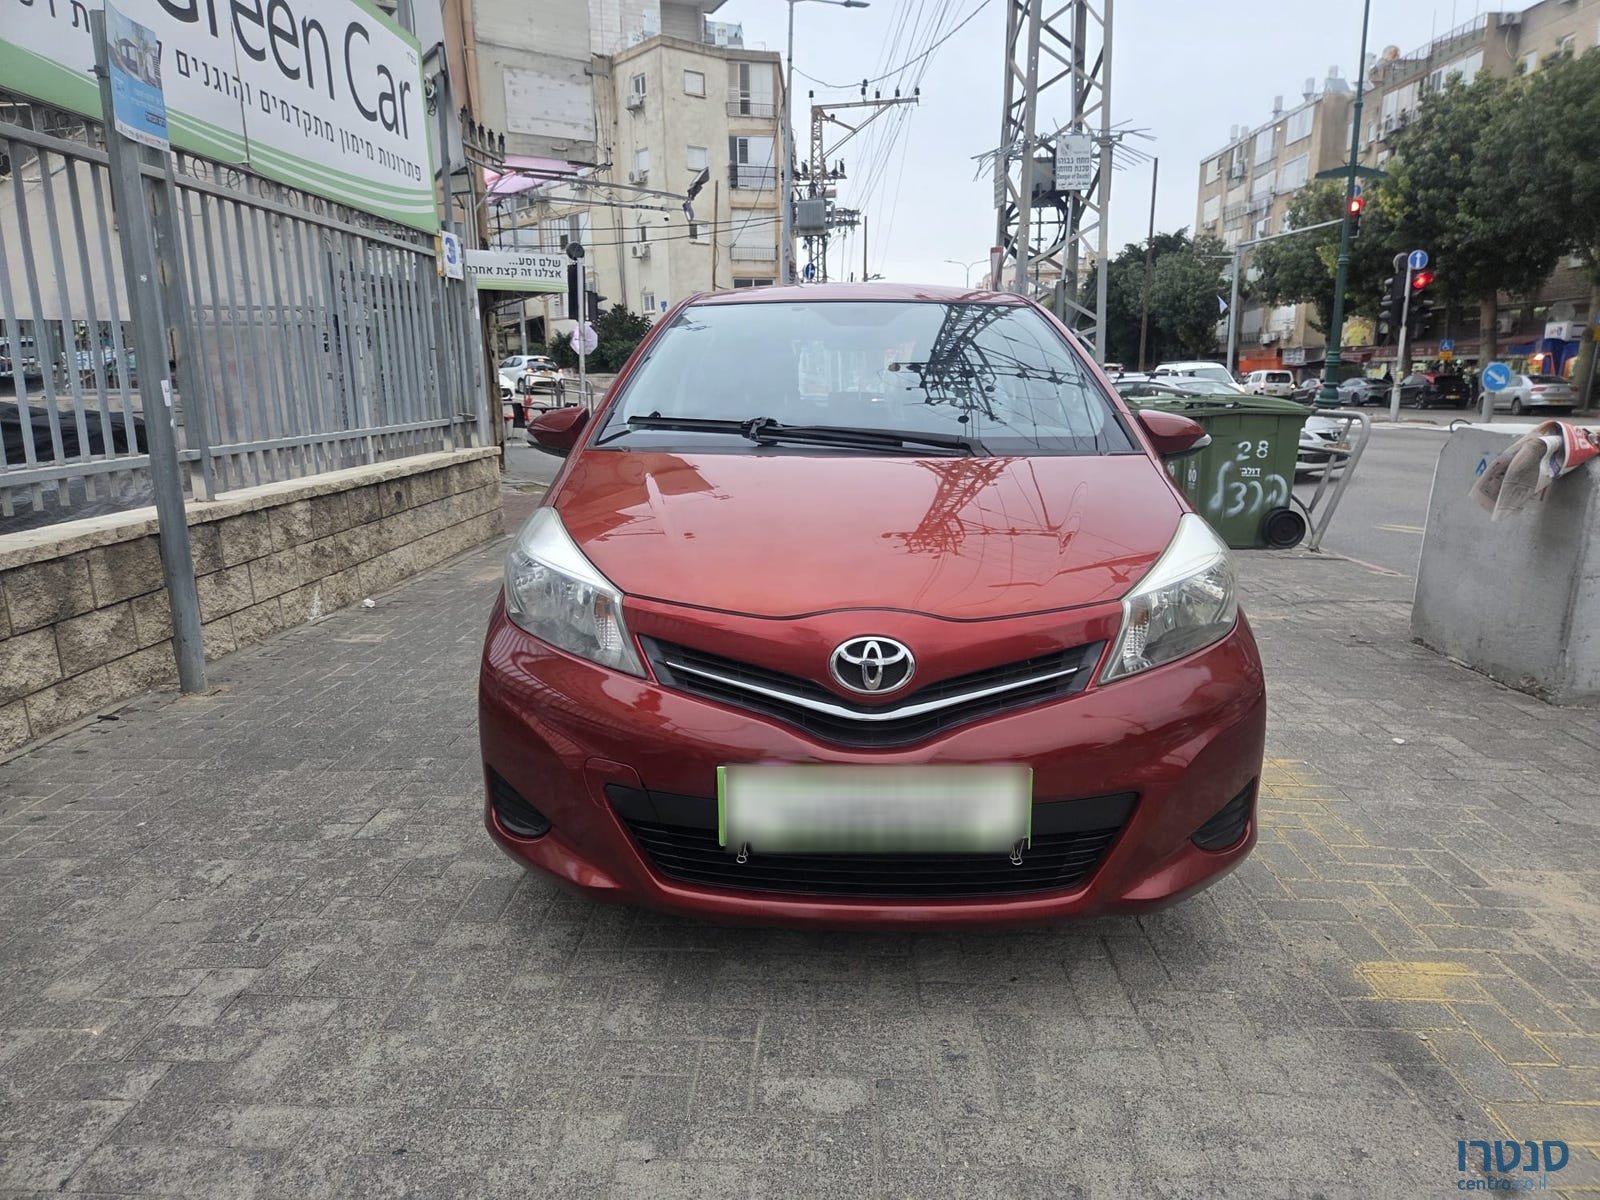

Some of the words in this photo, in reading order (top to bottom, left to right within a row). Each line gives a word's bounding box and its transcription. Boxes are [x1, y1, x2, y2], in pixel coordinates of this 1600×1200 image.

[157, 0, 335, 100] een
[344, 21, 411, 140] Car
[176, 49, 251, 105] והוגנים
[260, 89, 334, 143] מתקדמים
[339, 128, 374, 160] מימון
[378, 147, 422, 181] פתרונות
[496, 267, 517, 278] קצת
[520, 268, 532, 276] זה
[535, 267, 561, 278] אצלנו
[539, 257, 561, 268] שלם
[1236, 440, 1269, 461] 28
